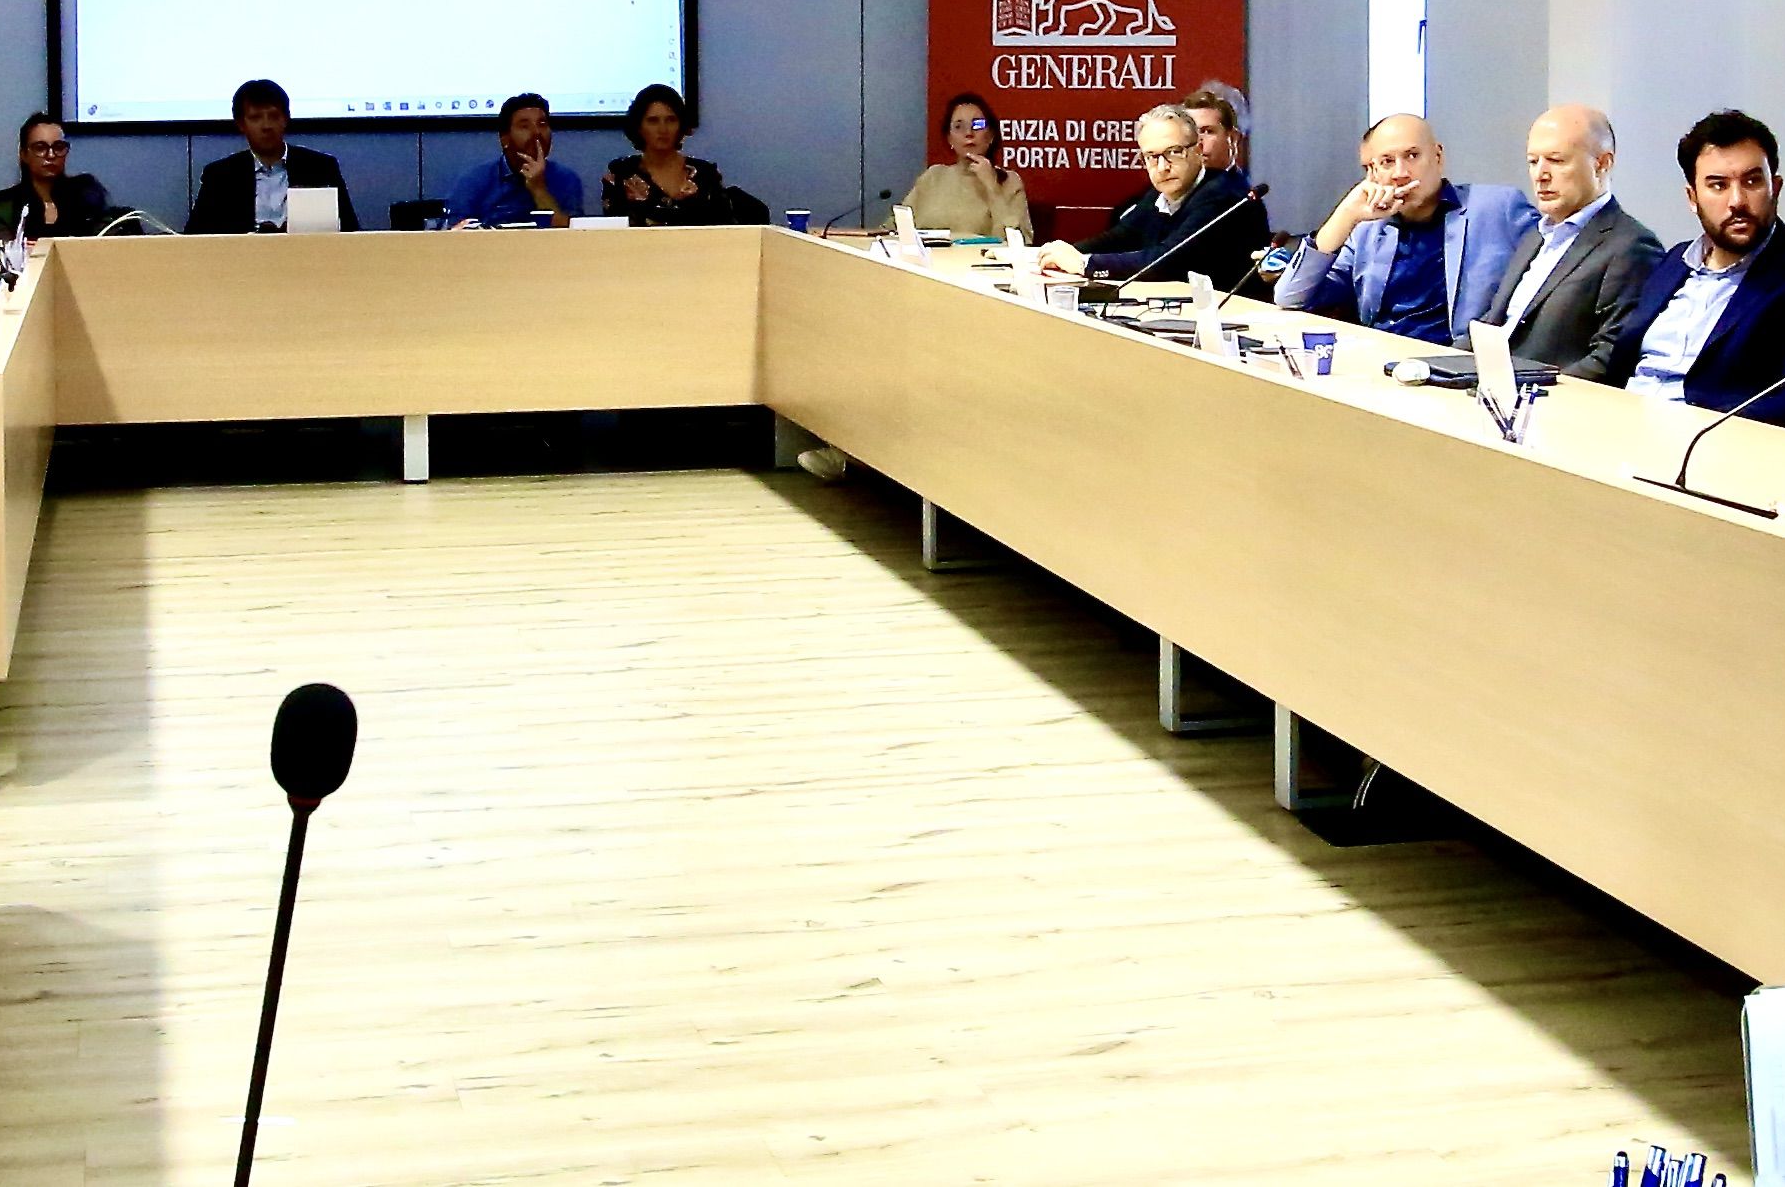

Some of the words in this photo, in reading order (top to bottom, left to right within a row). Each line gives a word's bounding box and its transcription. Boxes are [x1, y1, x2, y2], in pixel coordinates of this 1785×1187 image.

[991, 54, 1176, 90] GENERALI
[999, 119, 1059, 141] ENZIA
[1065, 120, 1086, 142] DI
[1002, 146, 1070, 169] PORTA
[1076, 147, 1146, 170] VENEZ
